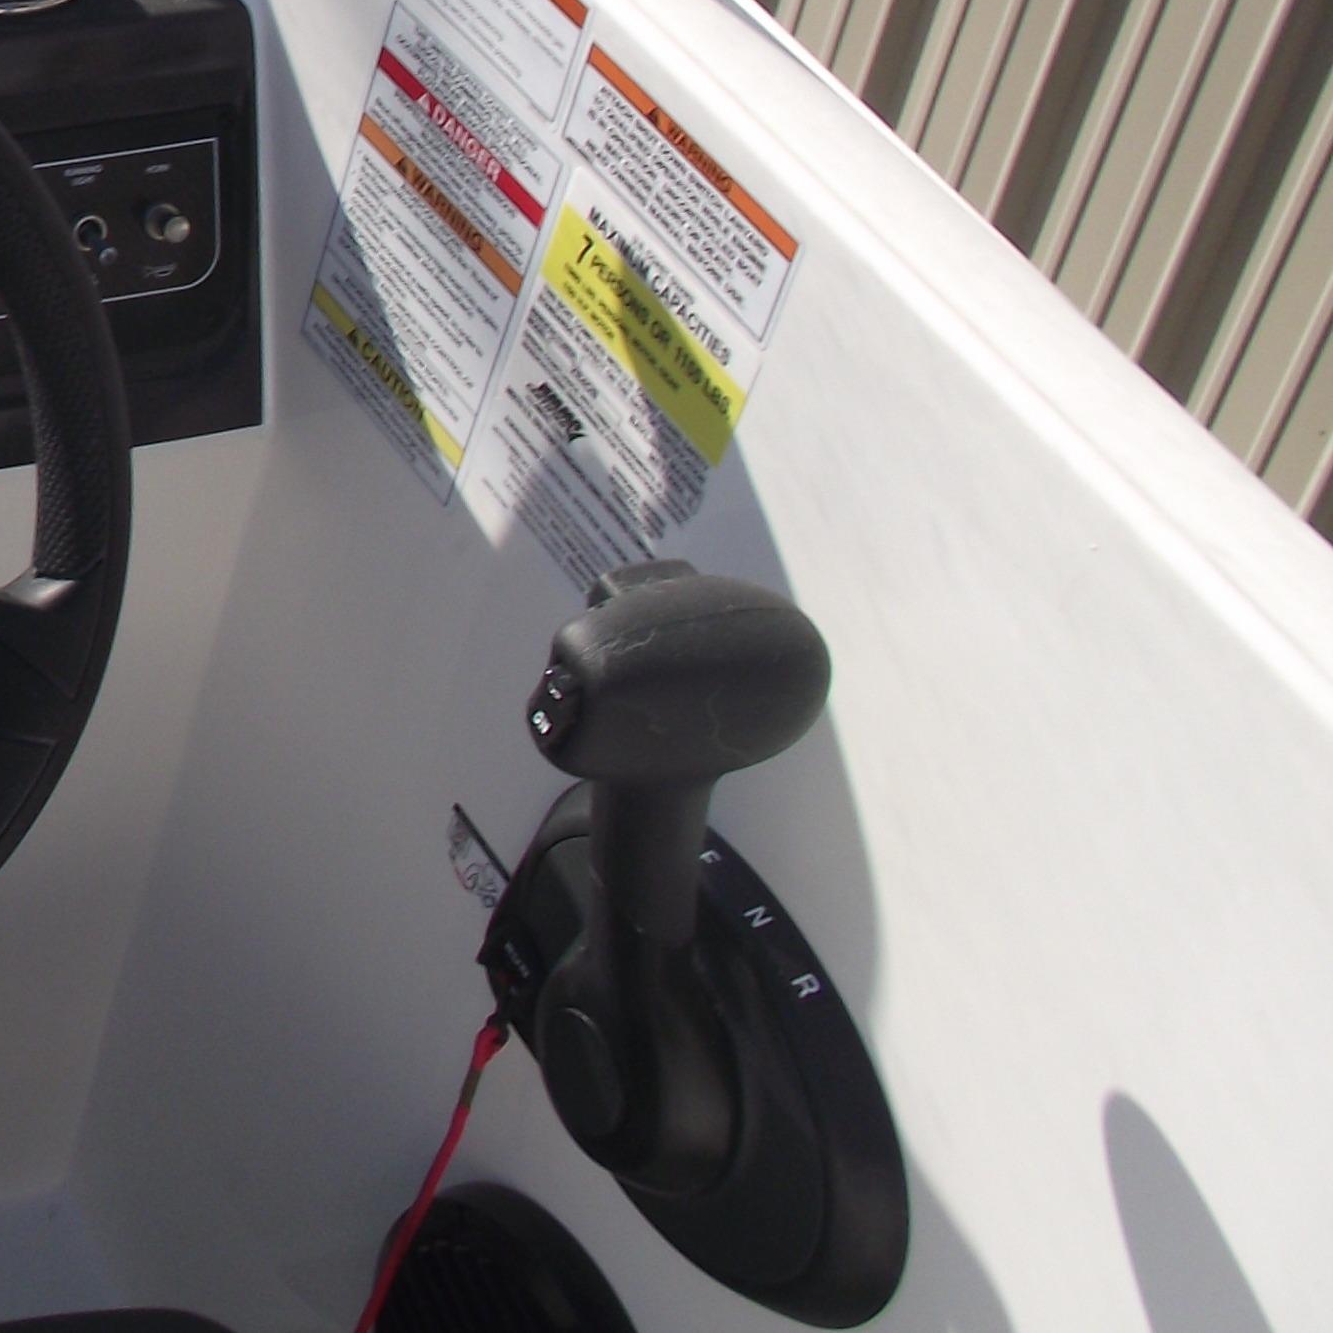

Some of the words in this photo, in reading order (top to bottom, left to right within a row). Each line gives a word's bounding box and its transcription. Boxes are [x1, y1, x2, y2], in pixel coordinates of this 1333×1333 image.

[431, 106, 501, 179] DANGER
[664, 125, 734, 190] WARNING
[409, 170, 485, 251] WARNING
[572, 234, 595, 266] 7
[588, 253, 652, 326] PERSONS
[647, 316, 674, 349] OR
[586, 205, 651, 280] MAXIMUM
[648, 274, 734, 367] CAPACITIES
[359, 341, 426, 420] CAUTION
[699, 849, 722, 864] F
[743, 905, 773, 928] N
[790, 973, 821, 999] R
